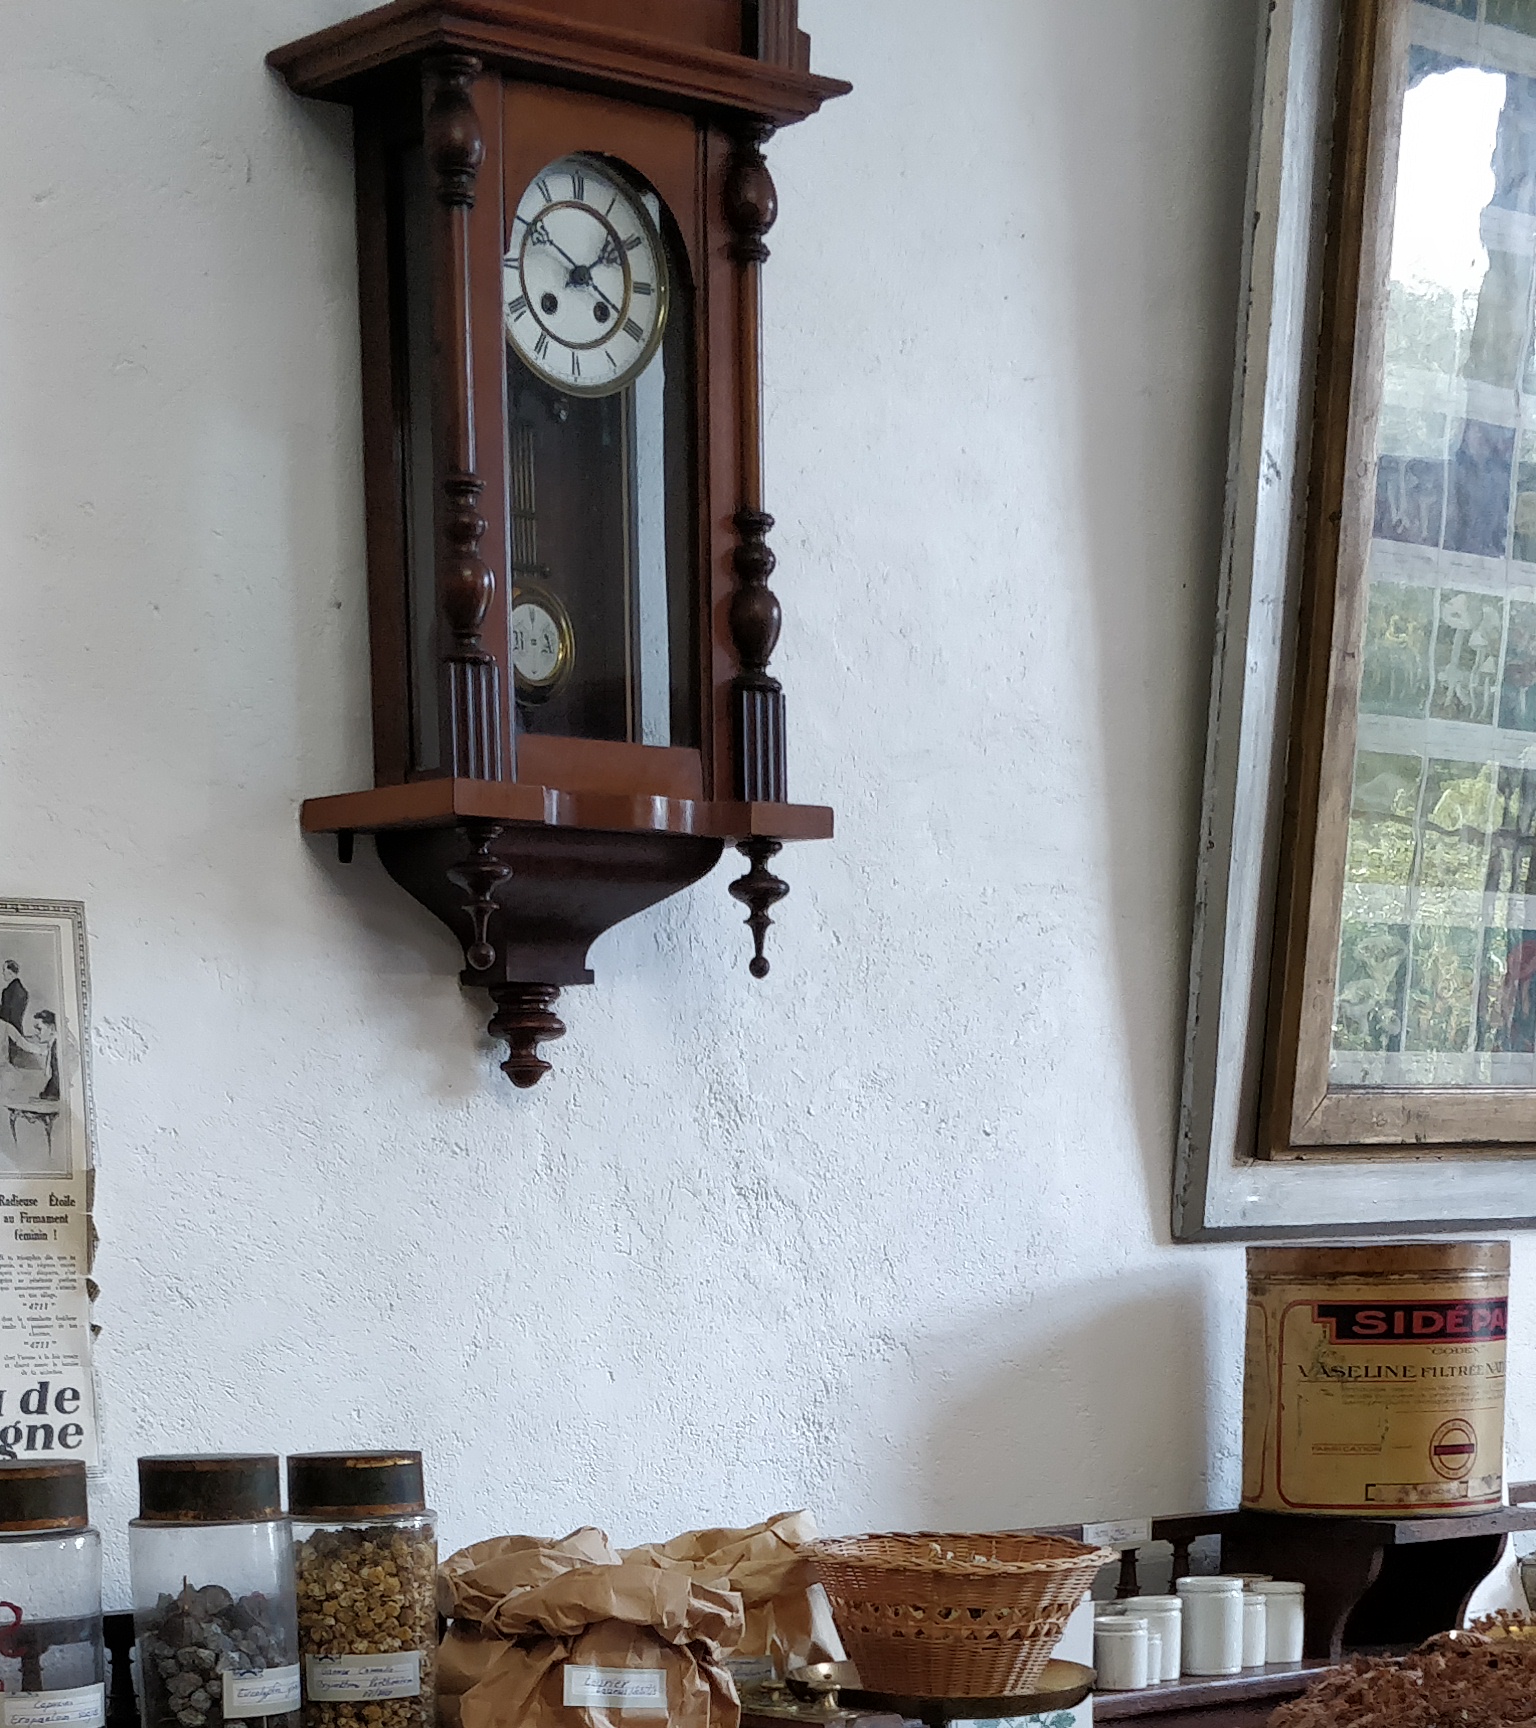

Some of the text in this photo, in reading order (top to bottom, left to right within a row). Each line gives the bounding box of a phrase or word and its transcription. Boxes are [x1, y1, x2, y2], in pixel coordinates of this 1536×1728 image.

[49, 1192, 76, 1207] Étoile
[4, 1212, 68, 1223] au Firmament
[15, 1229, 47, 1240] féminin
[1352, 1305, 1507, 1335] SIDÉPA
[1298, 1364, 1416, 1378] VASELINE
[20, 1381, 81, 1416] de
